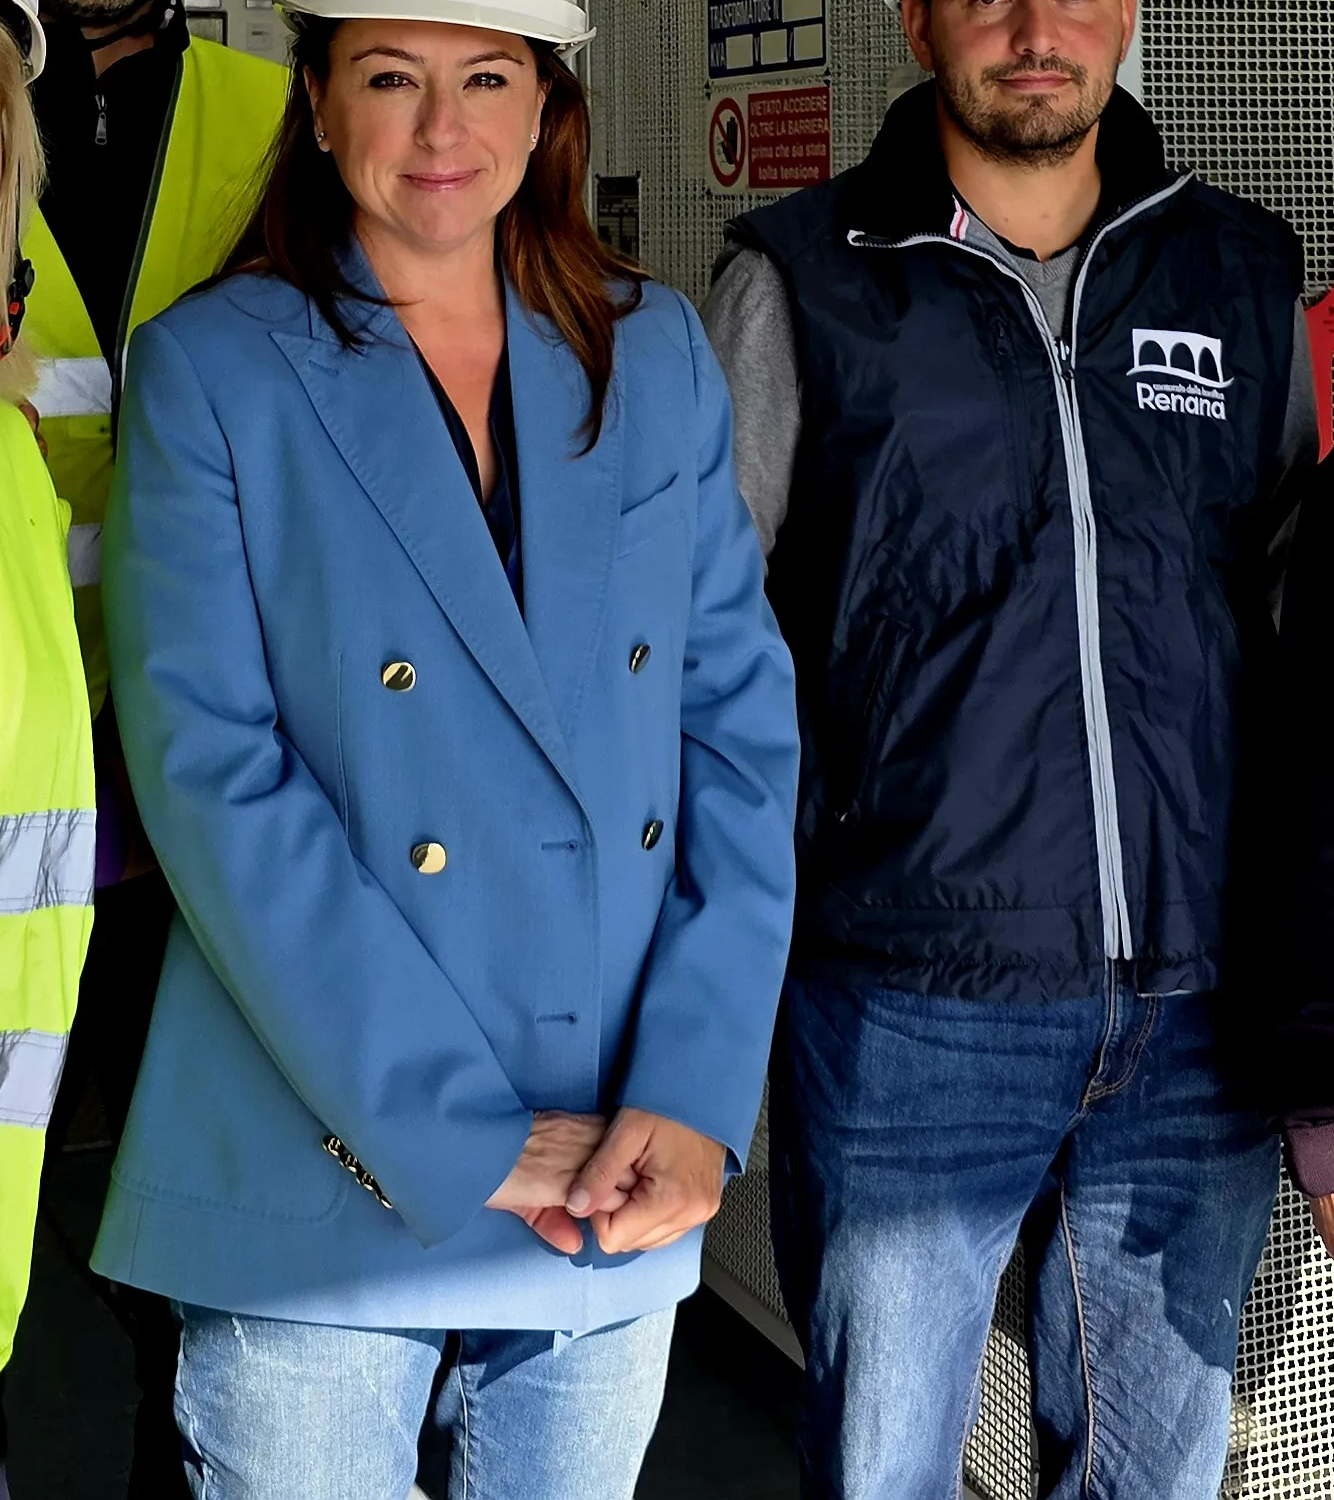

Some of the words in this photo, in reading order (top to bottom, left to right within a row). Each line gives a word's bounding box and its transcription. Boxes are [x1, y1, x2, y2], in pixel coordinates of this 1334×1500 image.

[750, 99, 781, 116] VIETATO
[783, 95, 827, 113] ACCEDERE
[750, 121, 774, 138] OLTRE
[776, 120, 786, 136] LA
[787, 118, 830, 136] BARRIERA
[775, 144, 790, 158] che
[780, 163, 819, 180] tensione
[1136, 381, 1227, 421] Renana
